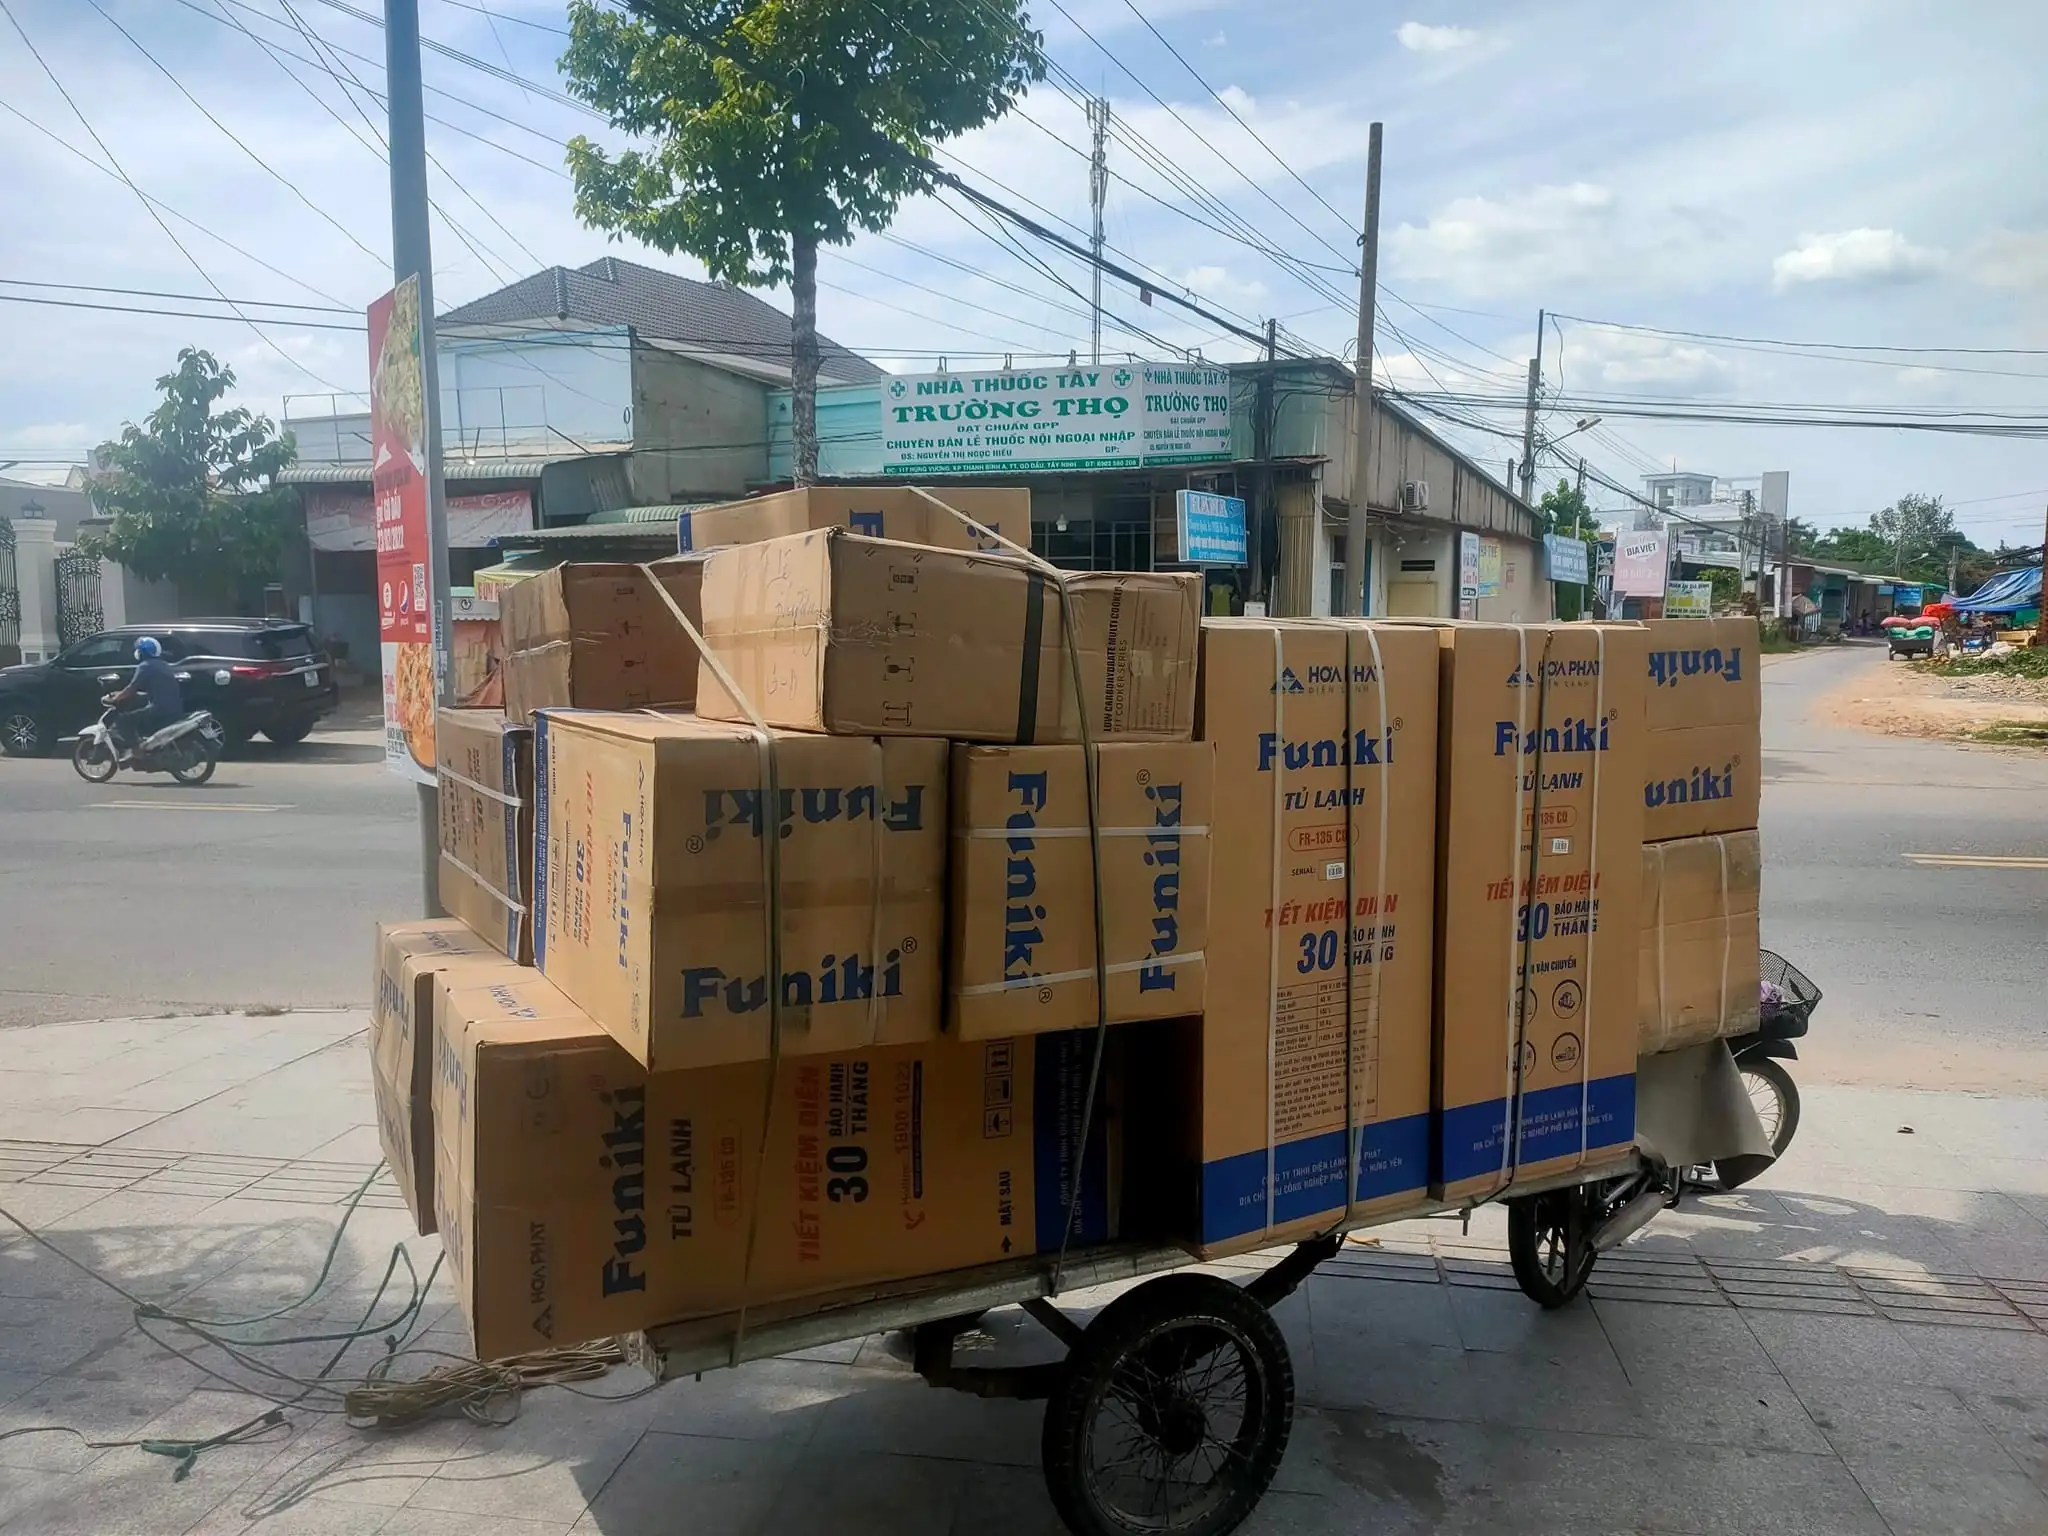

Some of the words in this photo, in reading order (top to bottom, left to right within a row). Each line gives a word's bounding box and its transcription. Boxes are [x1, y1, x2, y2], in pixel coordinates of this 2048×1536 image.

[917, 378, 964, 395] NHÀ
[972, 371, 1048, 393] THUỐC
[1056, 370, 1100, 389] TÂY
[1154, 368, 1172, 385] NHÀ
[892, 398, 1042, 423] TRƯỜNG
[1052, 396, 1129, 419] THỌ
[1145, 390, 1200, 412] TRƯỜNG
[1203, 395, 1228, 417] THỌ
[886, 438, 934, 450] CHUYÊN
[937, 436, 963, 448] BÁN
[985, 433, 1025, 446] THUỐC
[1029, 434, 1051, 446] NỘI
[1056, 432, 1095, 445] NGOẠI
[1100, 430, 1136, 444] NHẬP
[1033, 421, 1059, 430] GPP
[1626, 546, 1640, 556] BIA
[1116, 639, 1128, 673] SERIES
[1648, 647, 1741, 687] Funik
[1115, 676, 1125, 716] COOKER
[1284, 786, 1309, 811] TỦ
[1644, 763, 1733, 808] uniki
[703, 785, 926, 839] Funiki
[576, 839, 585, 883] 30
[619, 810, 632, 969] Funiki
[1004, 770, 1047, 994] Funiki
[1140, 782, 1182, 994] Funiki
[1520, 874, 1561, 899] KỆM
[1367, 924, 1396, 940] HNH
[1516, 901, 1550, 942] 30
[1296, 930, 1338, 974] 30
[680, 949, 903, 1018] Funiki
[794, 1065, 823, 1128] ĐIỆN
[848, 1061, 869, 1135] THÁNG
[825, 1107, 843, 1137] BẢO
[670, 1119, 695, 1193] LẠNH
[793, 1135, 823, 1202] KIỆM
[826, 1146, 869, 1203] 30
[599, 1083, 646, 1298] Funiki
[998, 1171, 1012, 1194] SAU
[666, 1204, 693, 1240] TỦ
[997, 1199, 1015, 1226] MẶT
[792, 1209, 820, 1263] TIẾT
